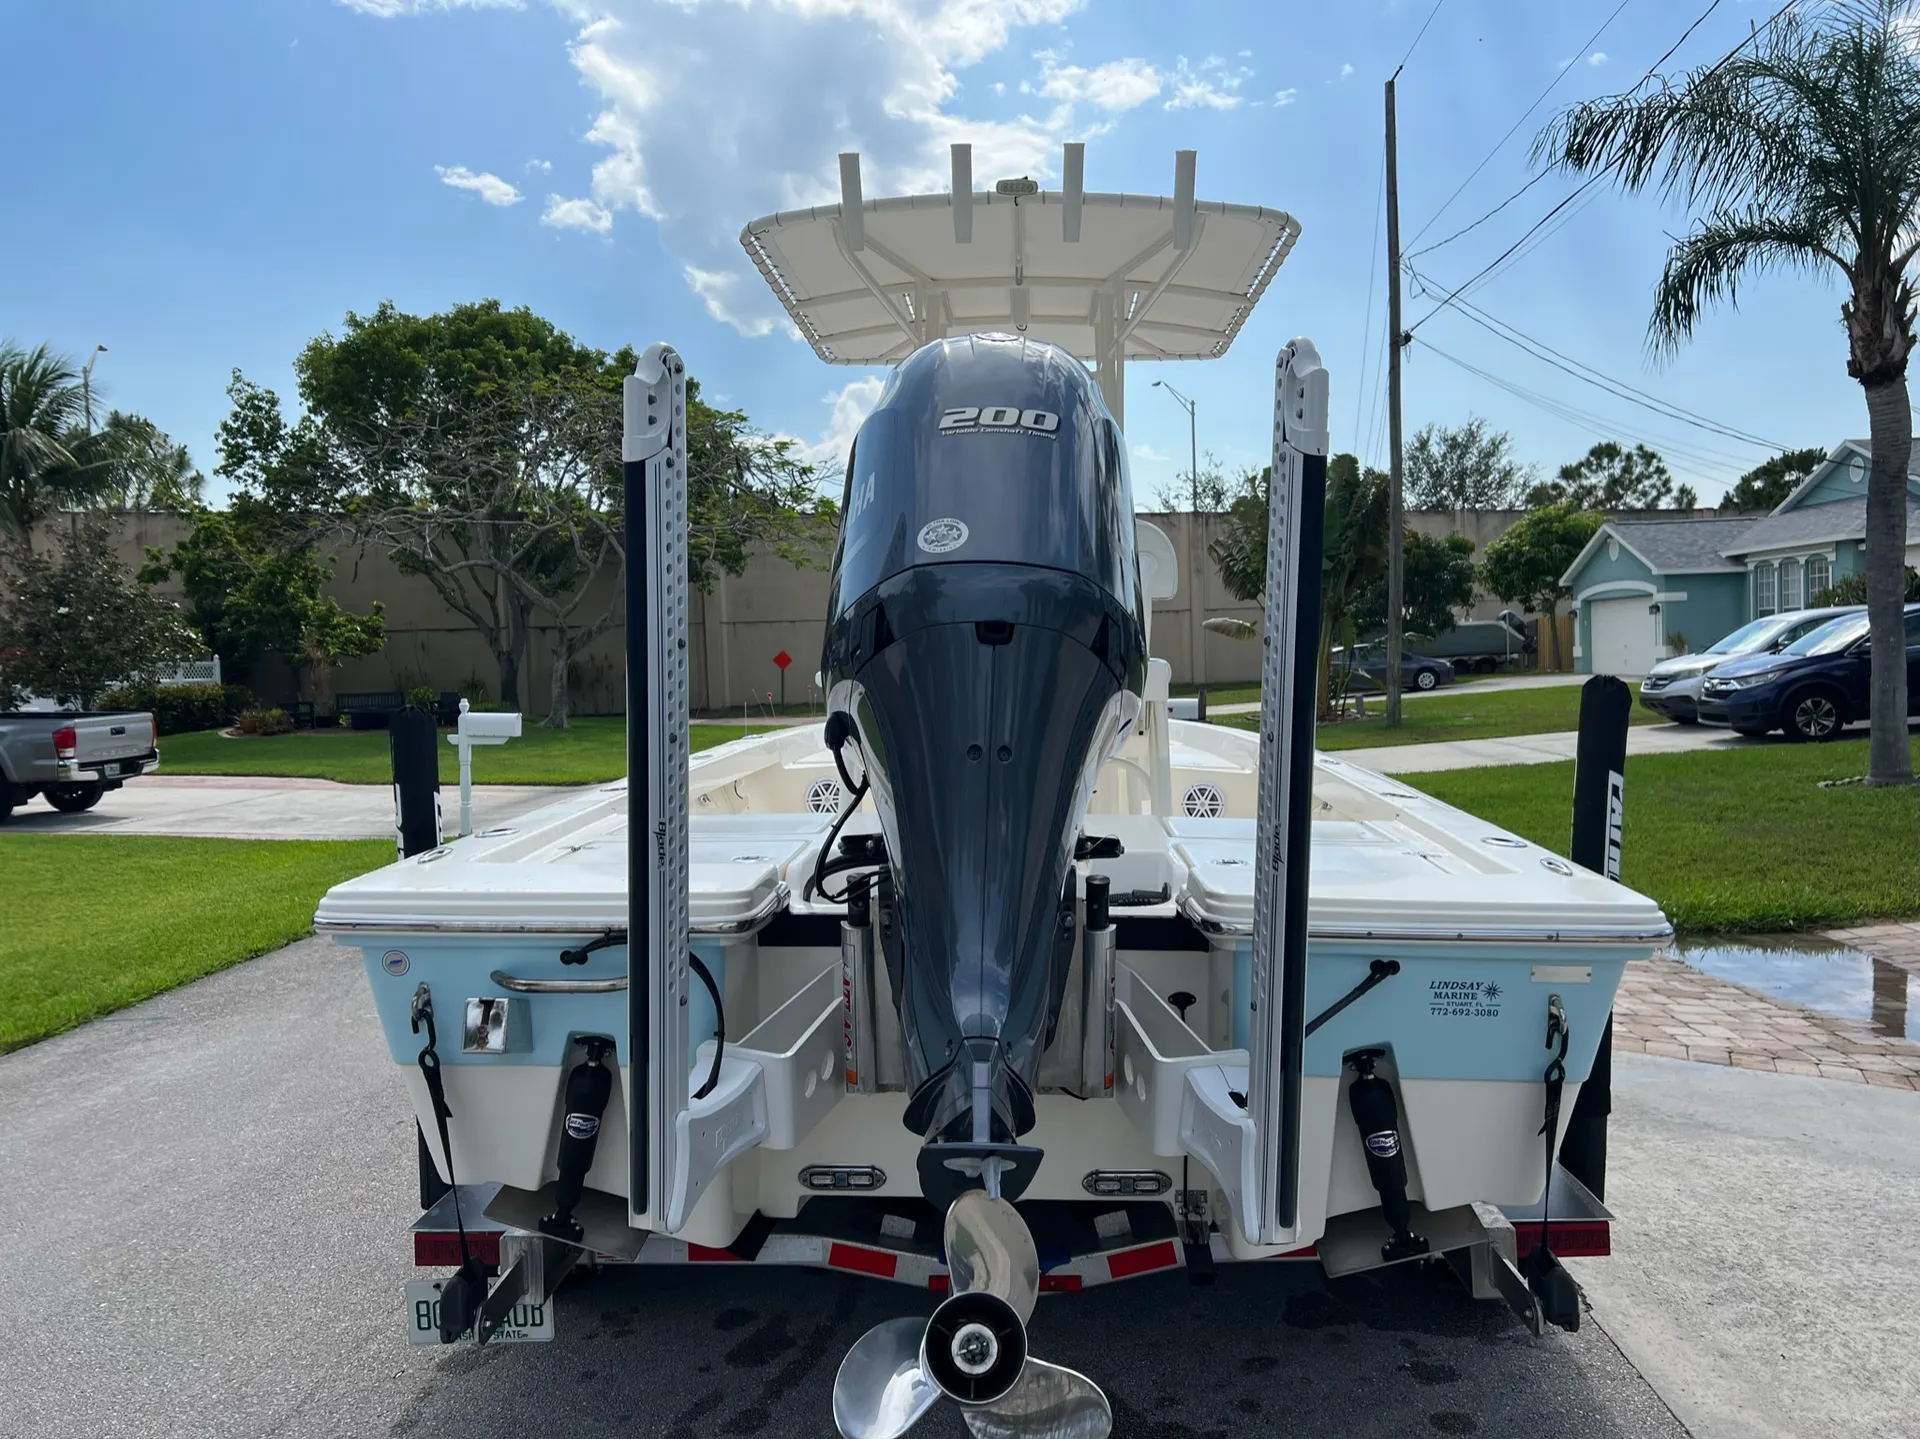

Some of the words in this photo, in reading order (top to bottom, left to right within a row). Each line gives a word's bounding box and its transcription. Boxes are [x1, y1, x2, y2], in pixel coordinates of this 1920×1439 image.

[938, 406, 1060, 432] 200
[941, 427, 979, 436] Variable
[980, 427, 1025, 435] Camshaft
[1027, 429, 1057, 440] Timing
[653, 821, 667, 867] Blade
[1271, 824, 1284, 872] Blade
[1429, 981, 1484, 990] LINDSAY
[1433, 991, 1478, 1000] MARINE
[1430, 1007, 1499, 1017] 772-692-3080
[493, 1330, 522, 1340] STATE
